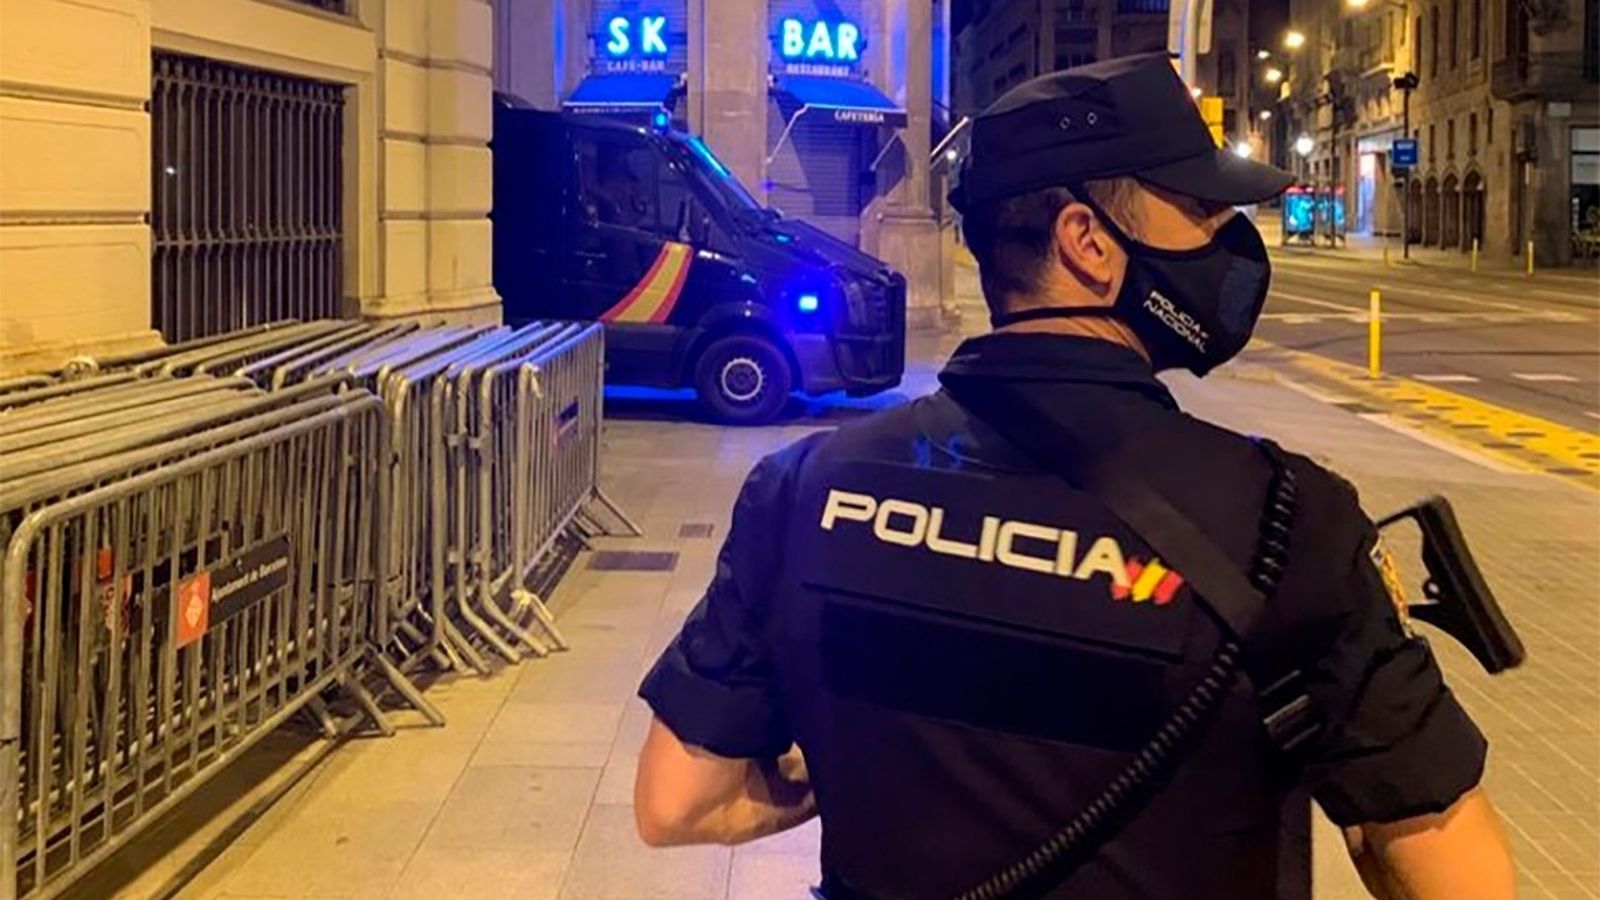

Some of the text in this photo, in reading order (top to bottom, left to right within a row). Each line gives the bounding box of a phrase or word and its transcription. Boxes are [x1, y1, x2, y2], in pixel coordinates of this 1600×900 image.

[783, 18, 858, 60] BAR
[1143, 300, 1206, 353] NACIONAL
[1150, 290, 1202, 331] POLICIA
[820, 489, 1132, 588] POLICIA
